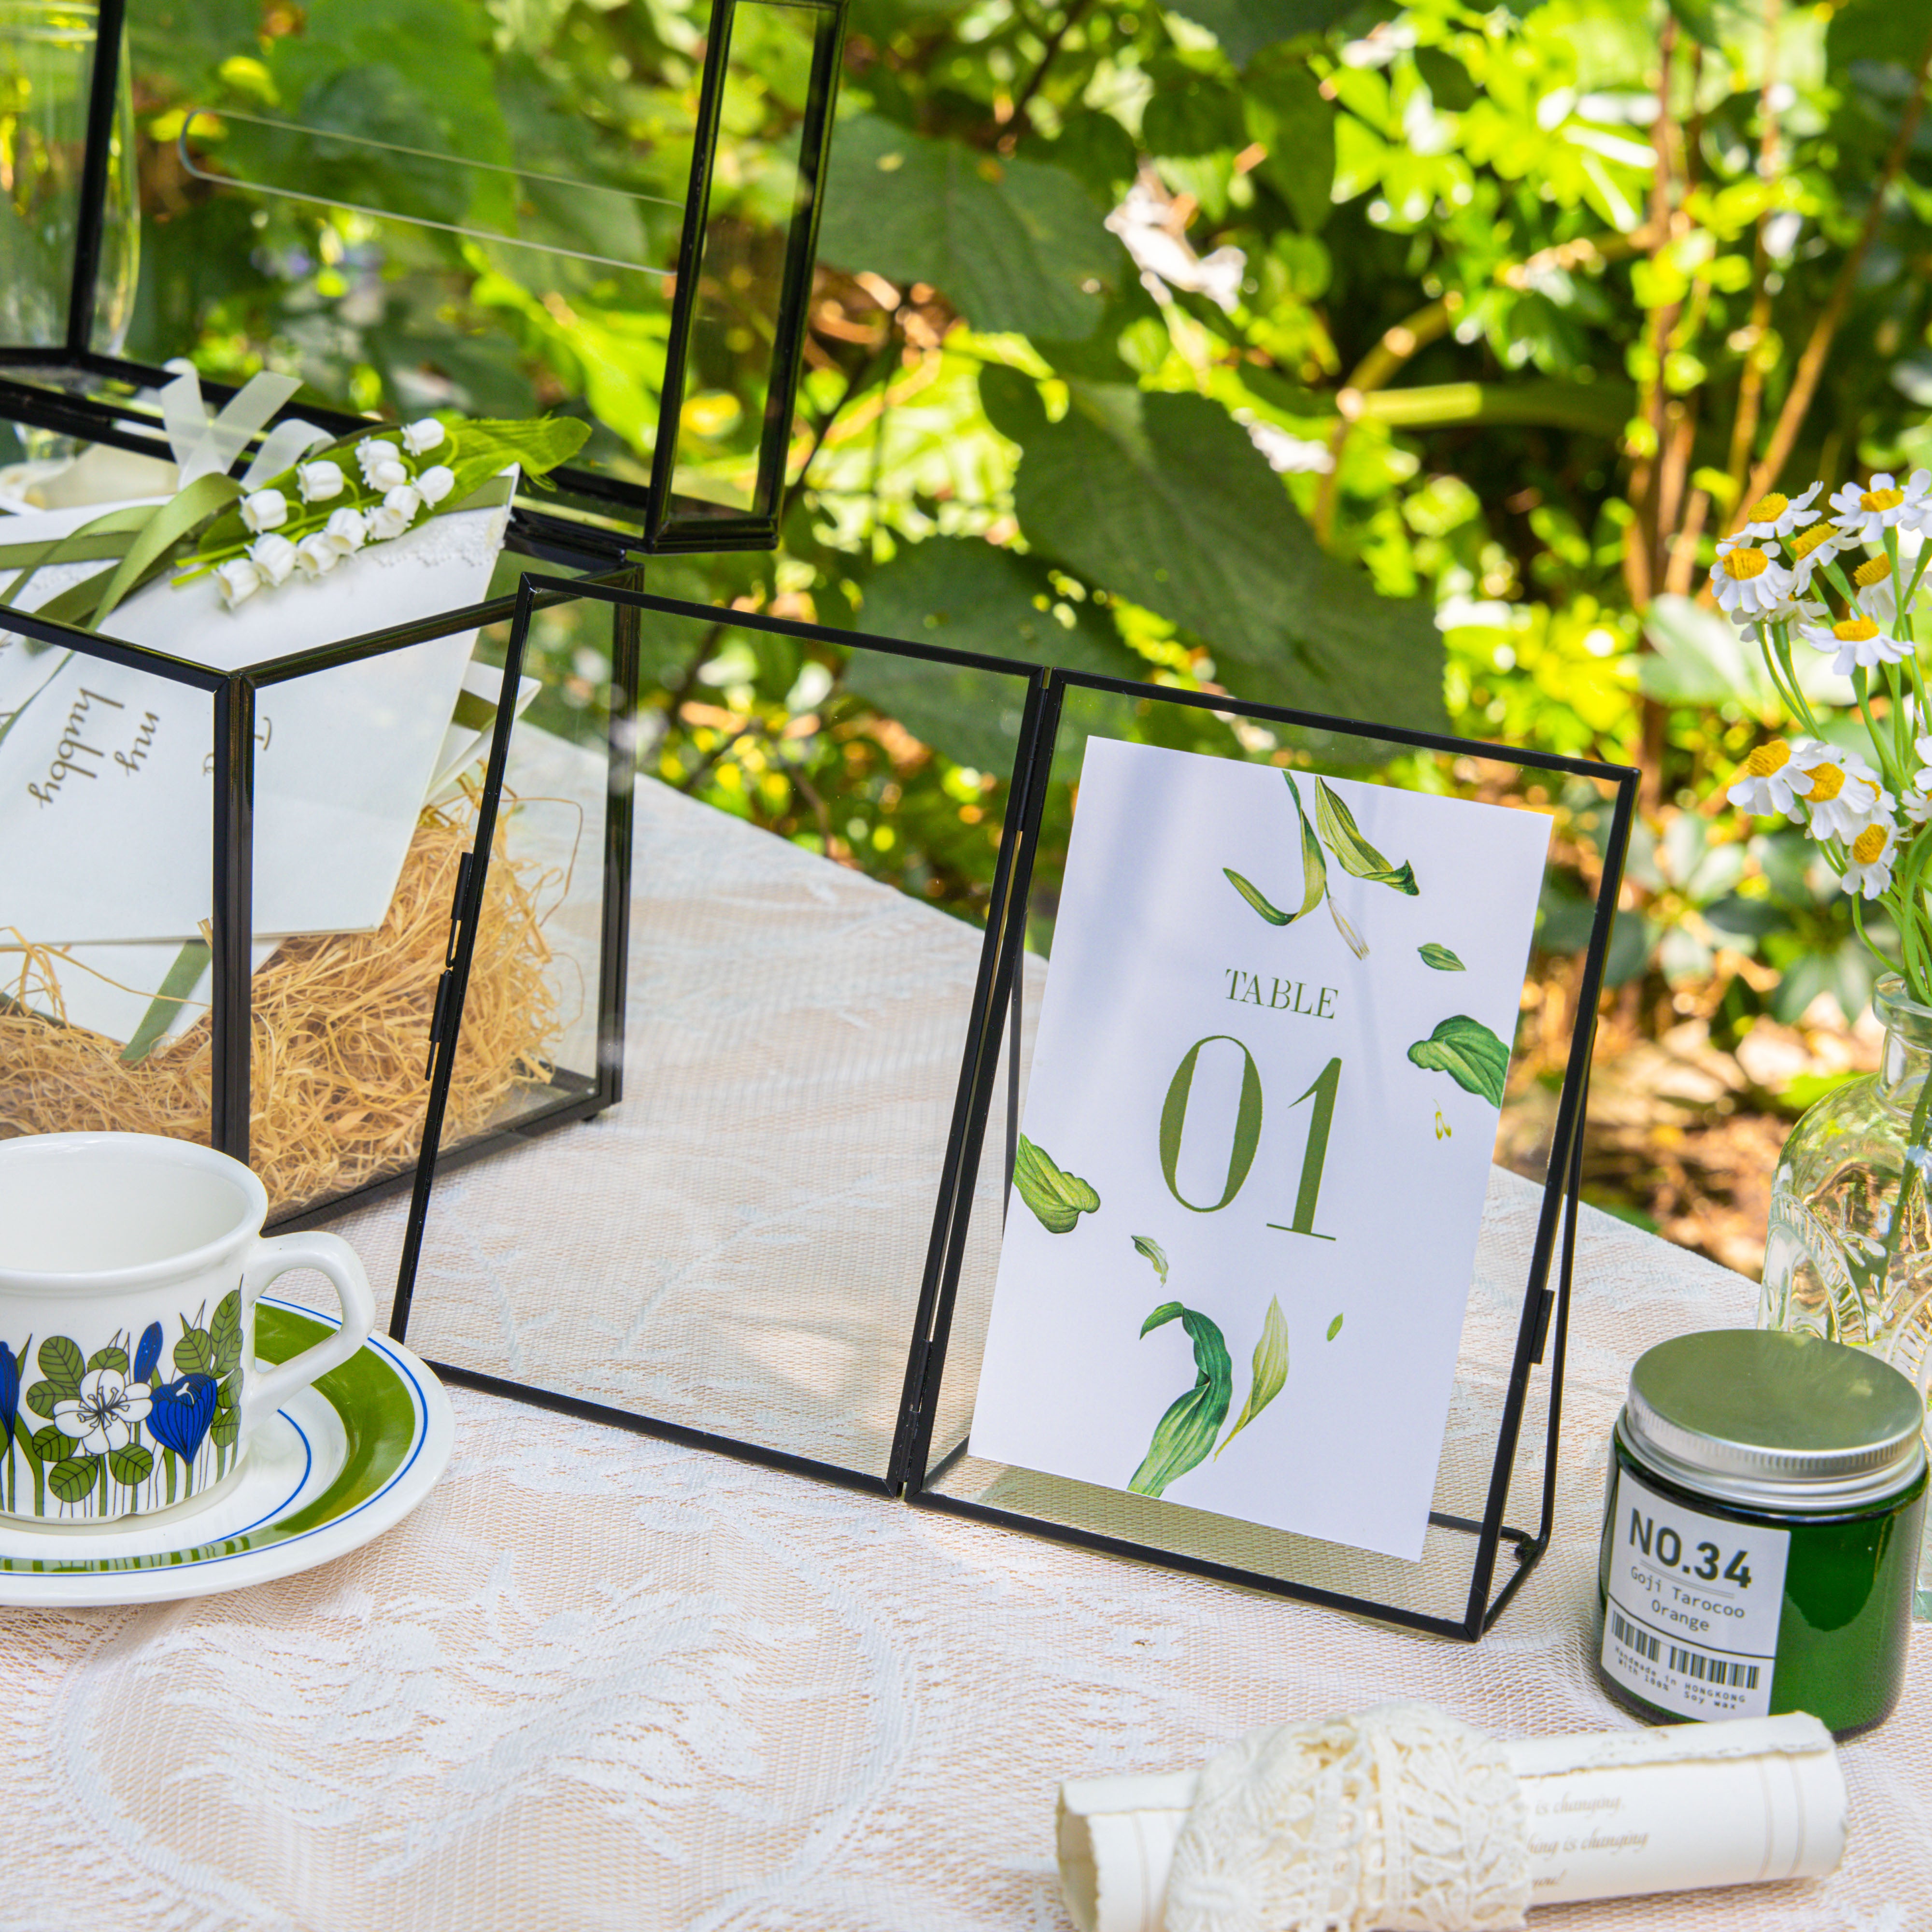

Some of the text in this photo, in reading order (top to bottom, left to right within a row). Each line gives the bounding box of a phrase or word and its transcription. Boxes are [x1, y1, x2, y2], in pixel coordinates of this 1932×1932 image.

[28, 687, 125, 808] hubby
[114, 711, 160, 776] my
[1225, 969, 1338, 1019] TABLE
[1159, 1035, 1342, 1241] 01
[1629, 1507, 1752, 1589] NO.34
[1631, 1566, 1745, 1619] Goji Tarocoo
[1651, 1600, 1710, 1632] Orange
[1615, 1646, 1746, 1703] Handmade in HONGKONG
[1644, 1675, 1670, 1691] 100%
[1684, 1690, 1705, 1705] Soy
[1714, 1700, 1736, 1710] wax
[1535, 1800, 1548, 1815] is
[1563, 1835, 1577, 1853] is
[1580, 1827, 1650, 1855] changing
